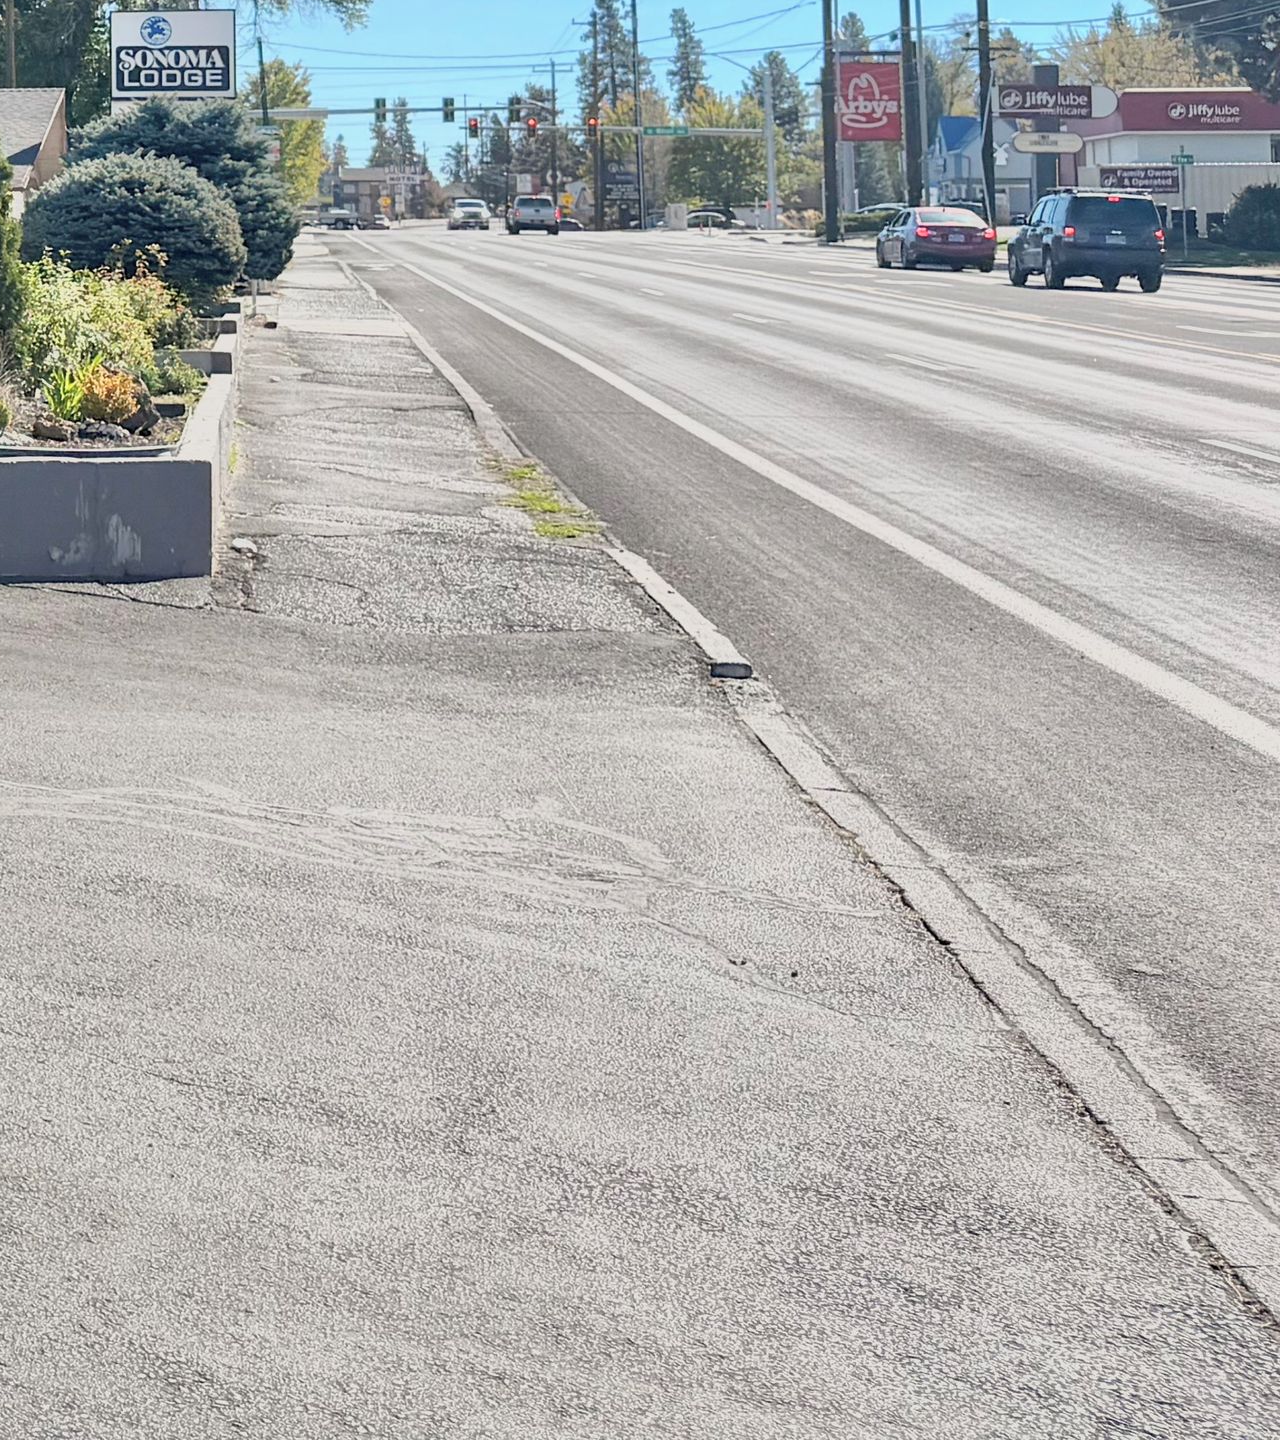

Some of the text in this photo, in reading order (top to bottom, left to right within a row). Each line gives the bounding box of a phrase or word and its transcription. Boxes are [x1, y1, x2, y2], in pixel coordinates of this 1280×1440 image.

[118, 48, 225, 72] SONOMA
[123, 69, 222, 87] LODGE
[833, 95, 898, 118] Arby's
[1117, 169, 1178, 178] Family Owned
